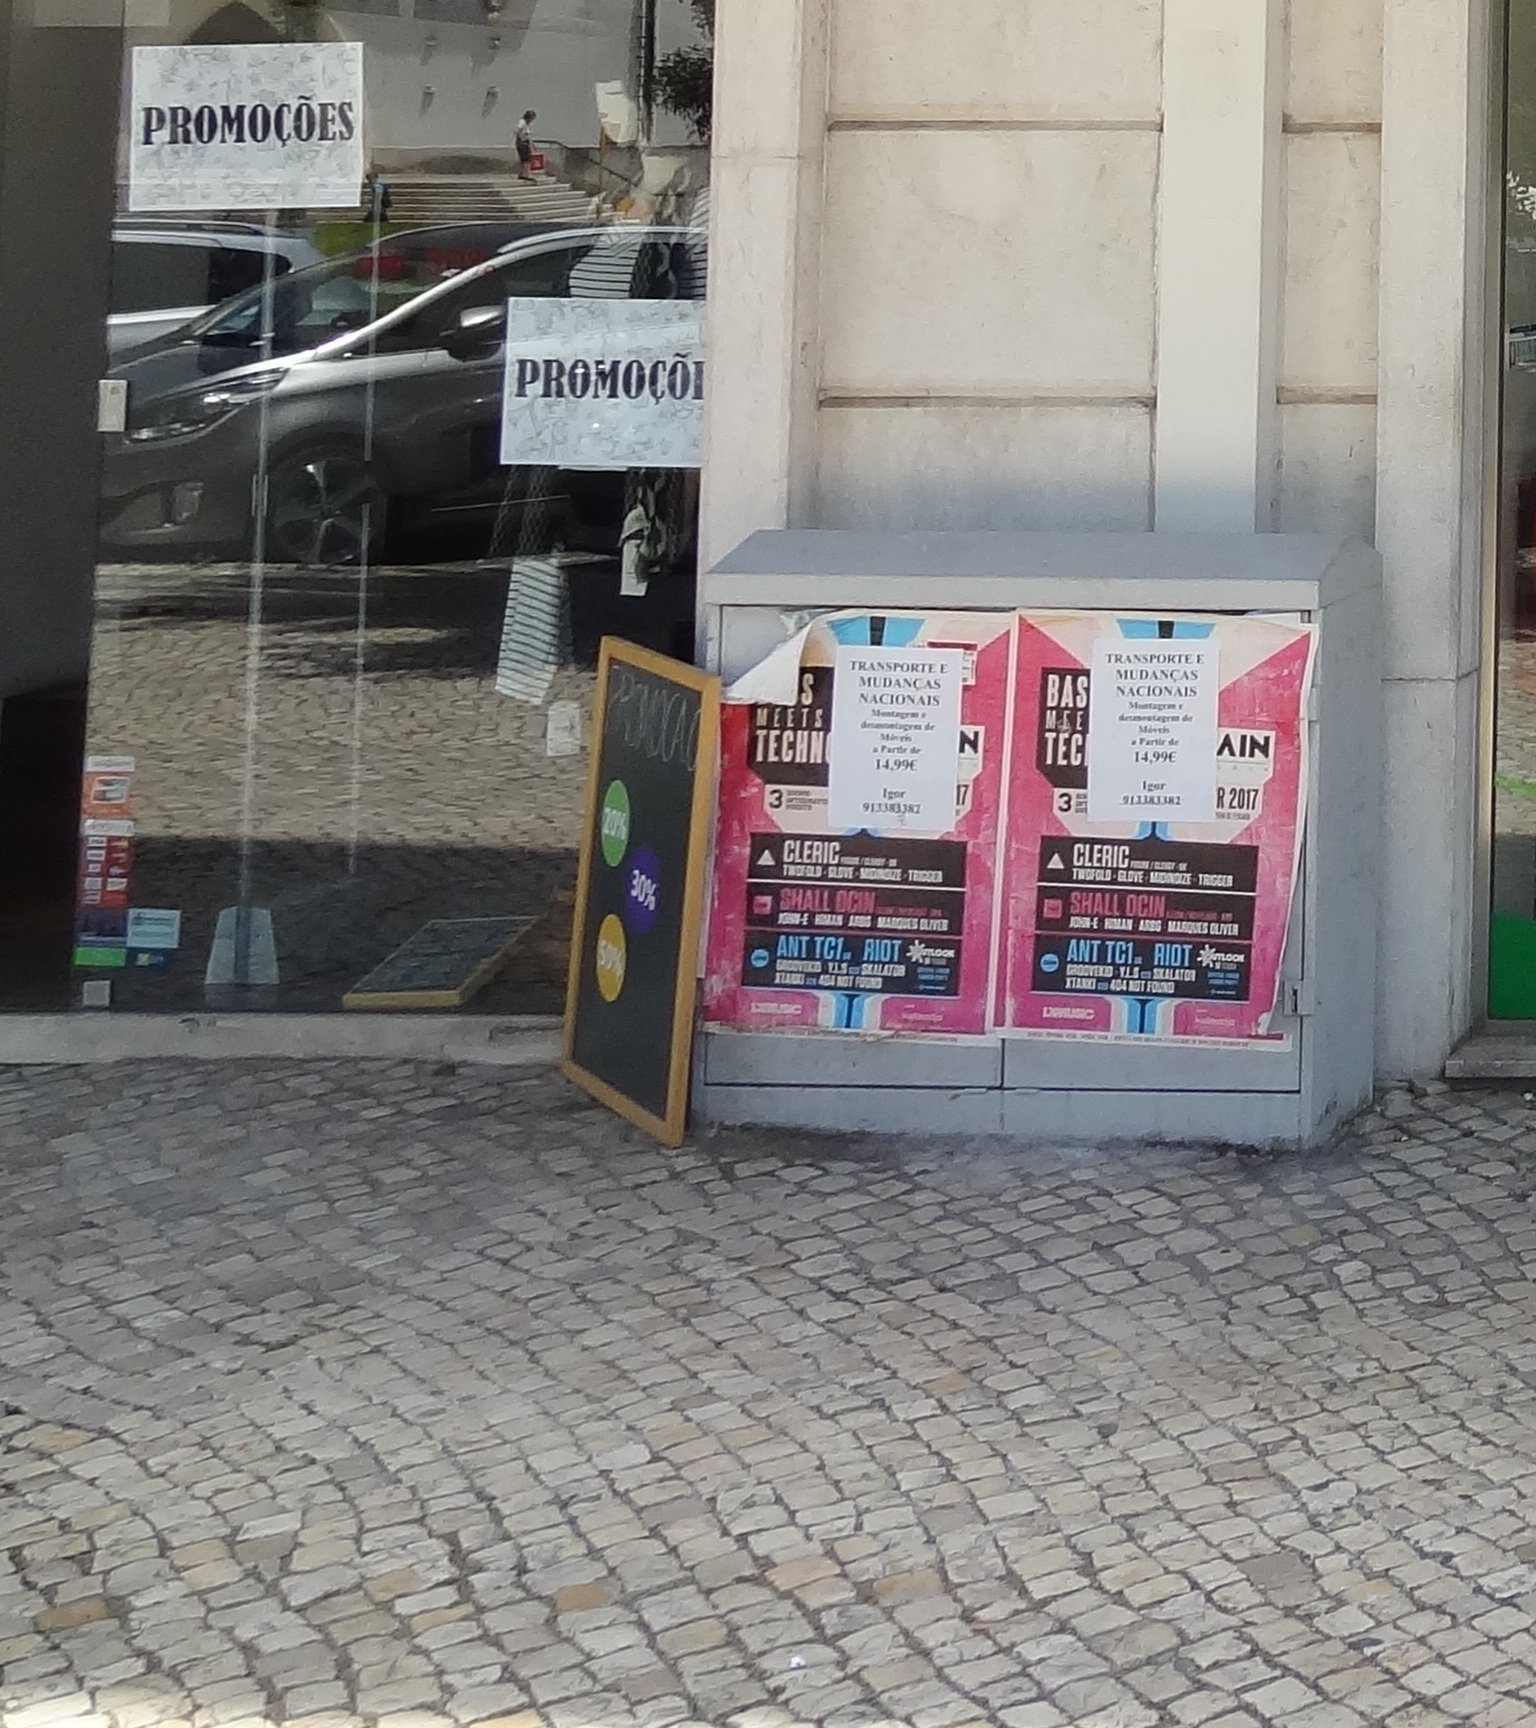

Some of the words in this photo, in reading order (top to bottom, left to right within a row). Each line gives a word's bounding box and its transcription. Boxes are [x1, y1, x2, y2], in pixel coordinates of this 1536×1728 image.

[142, 94, 355, 149] PROMOÇÕES
[849, 660, 936, 674] TRANSPORTE
[940, 663, 949, 674] E
[1105, 654, 1193, 664] TRANSPORTE
[1196, 654, 1205, 664] E
[858, 676, 941, 691] MUDANÇAS
[1115, 669, 1199, 683] MUDANÇAS
[858, 693, 940, 706] NACIONAIS
[1046, 674, 1089, 709] BAS
[1116, 685, 1198, 697] NACIONAIS
[756, 707, 824, 728] MEETS
[1045, 709, 1084, 731] MEE
[755, 729, 832, 764] TECHN
[1045, 732, 1089, 766] TEC
[1216, 733, 1271, 759] AIN
[1134, 751, 1177, 765] 14,99€
[882, 788, 907, 800] Igor
[1142, 780, 1167, 792] Igor
[768, 788, 783, 809] 3
[1057, 792, 1072, 813] 3
[1228, 787, 1260, 811] 2017
[782, 839, 840, 864] CLERIC
[1072, 843, 1130, 868] CLERIC
[630, 869, 656, 911] 30%
[779, 888, 829, 911] SHALL
[1069, 891, 1119, 916] SHALL
[776, 935, 810, 958] ANT
[814, 936, 844, 960] TC1
[863, 938, 902, 962] RIOT
[1066, 939, 1102, 962] ANT
[1105, 940, 1134, 964] TC1
[1154, 943, 1193, 967] RIOT
